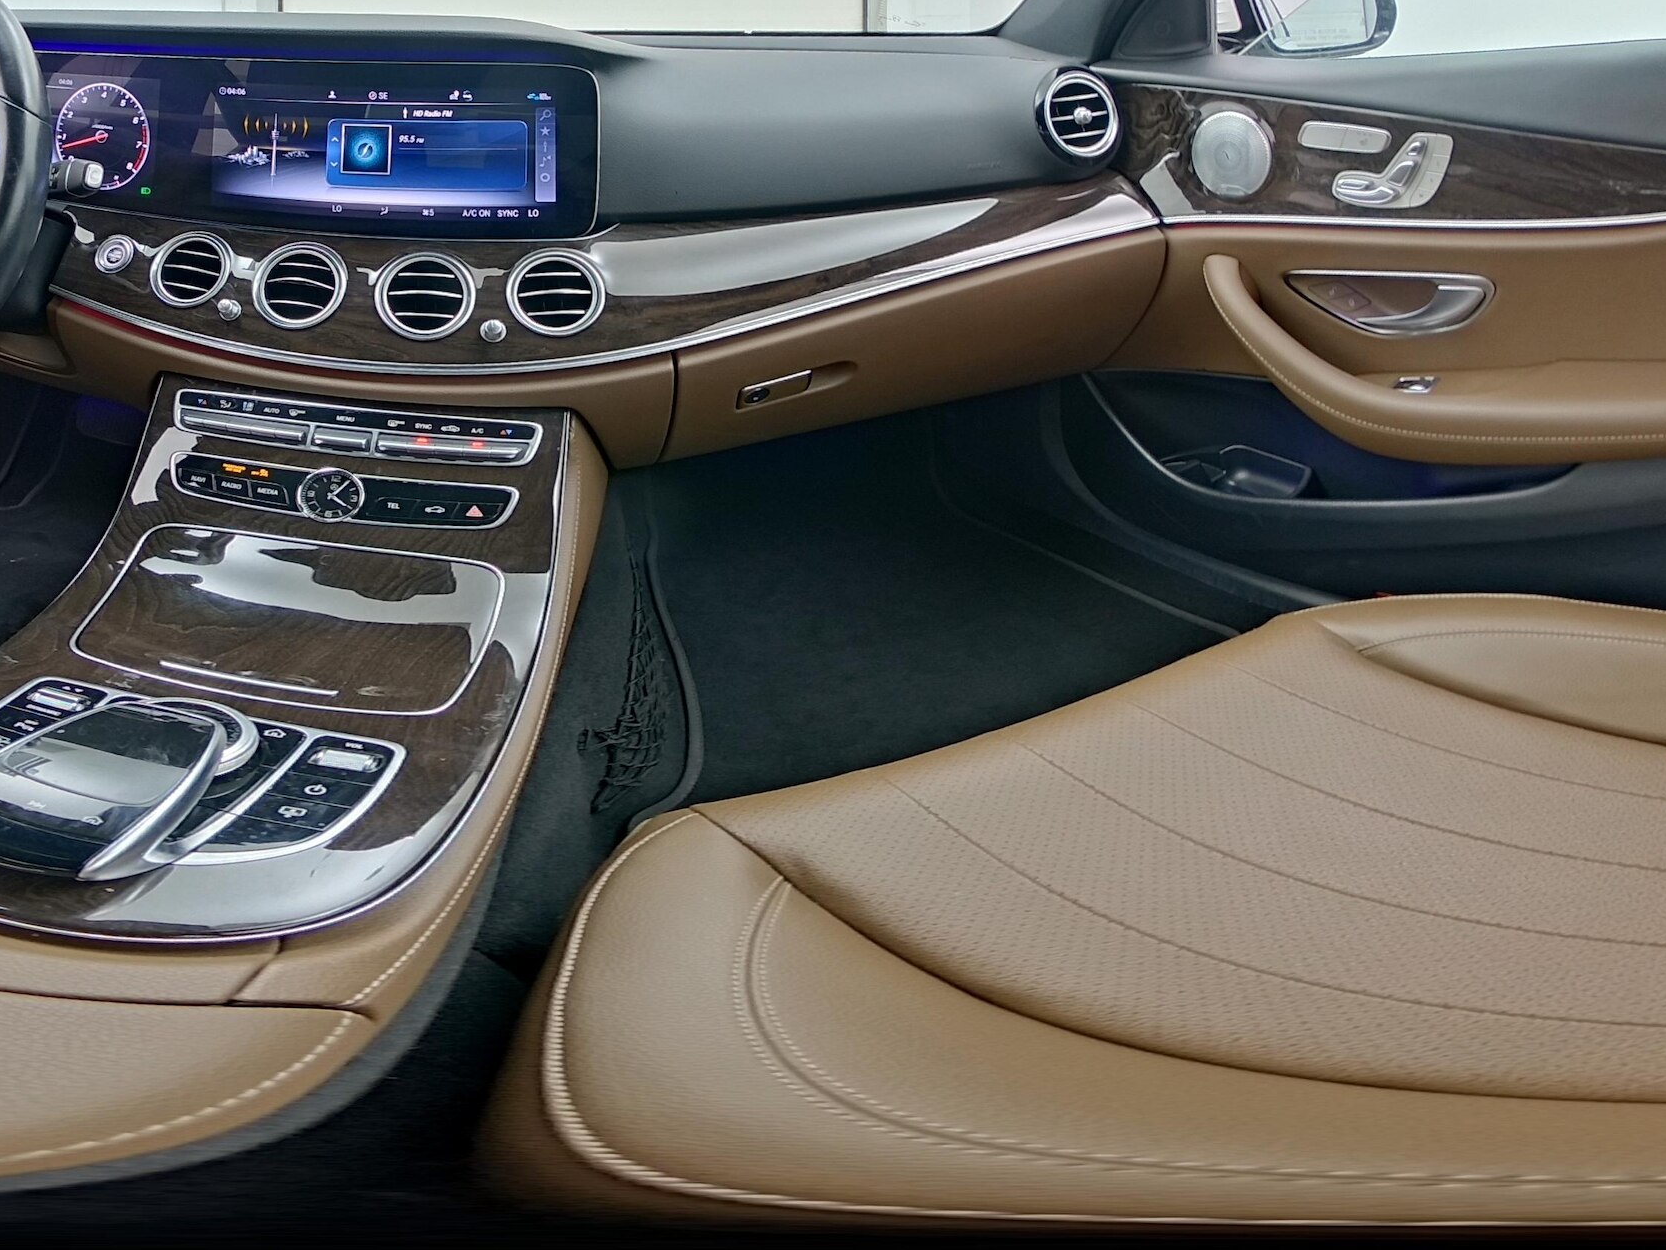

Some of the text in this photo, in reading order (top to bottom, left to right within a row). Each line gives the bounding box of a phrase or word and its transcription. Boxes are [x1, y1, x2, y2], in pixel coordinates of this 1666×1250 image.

[226, 87, 246, 95] 04:06
[378, 92, 388, 100] SE
[398, 135, 415, 143] 95.5
[332, 205, 342, 213] LO
[462, 209, 491, 217] A/C ON
[497, 209, 519, 218] SYNC
[528, 209, 539, 218] LO
[191, 475, 206, 483] NAVI
[331, 475, 341, 483] 12
[221, 481, 242, 490] RADIO
[257, 487, 278, 496] MEDIA
[387, 502, 400, 510] TEL
[345, 742, 364, 750] VOL
